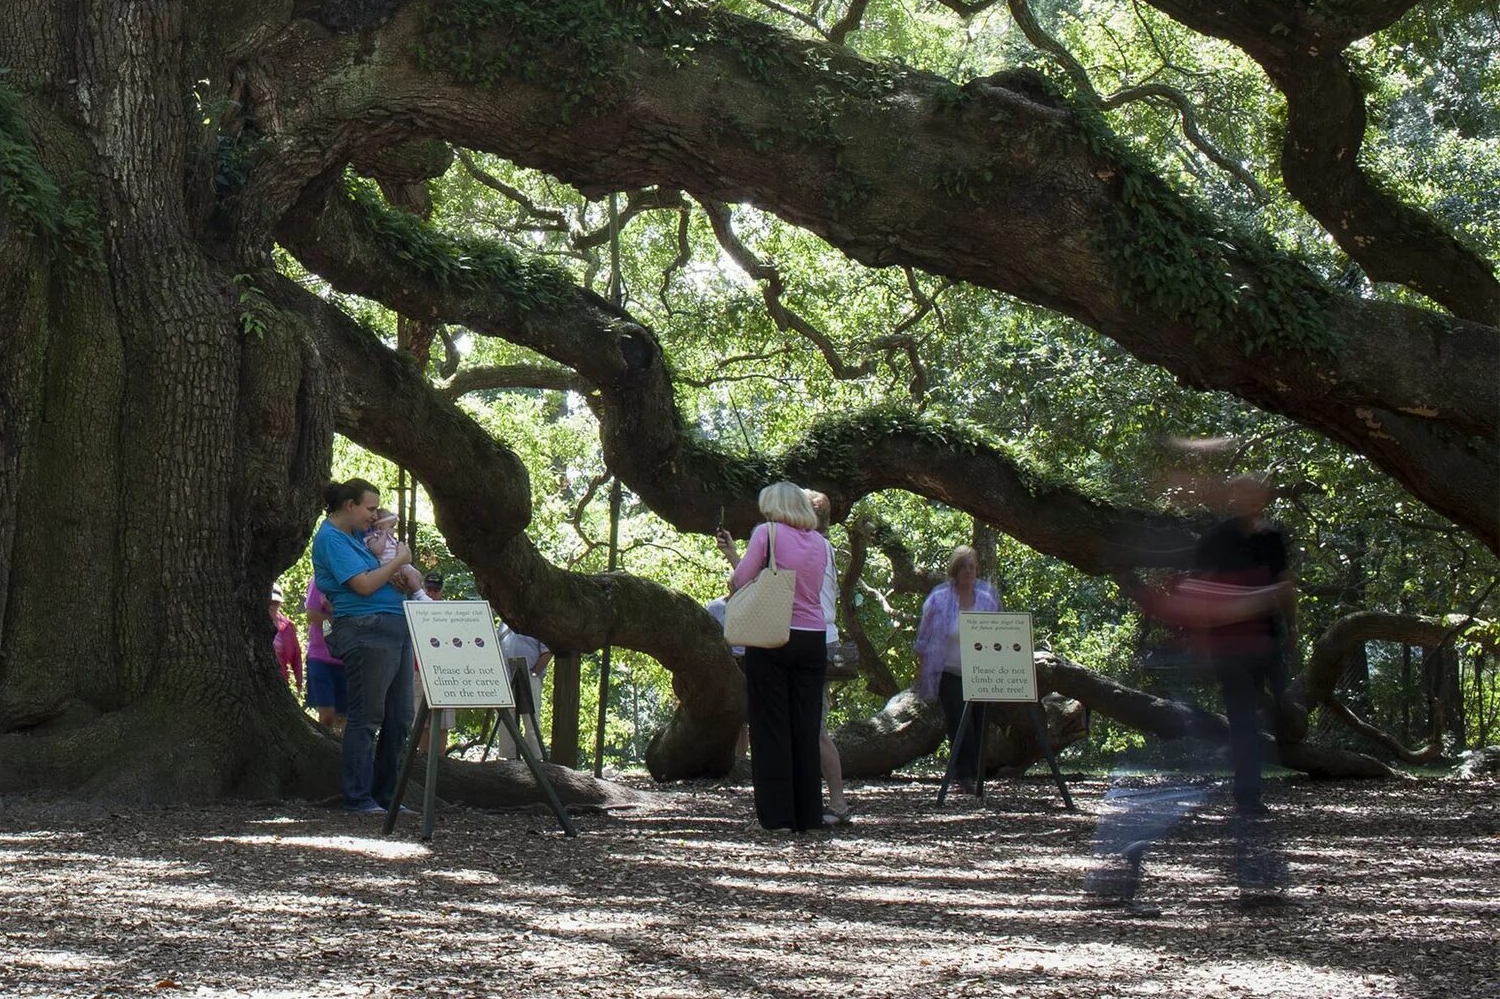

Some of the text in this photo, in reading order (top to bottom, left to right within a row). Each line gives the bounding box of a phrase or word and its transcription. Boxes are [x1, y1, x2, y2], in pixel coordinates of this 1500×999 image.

[433, 665, 494, 675] Please do not
[972, 666, 996, 674] Please
[998, 666, 1009, 674] do
[434, 677, 459, 686] climb
[971, 675, 993, 683] climb
[444, 688, 497, 698] on the tree!
[991, 685, 1003, 693] the
